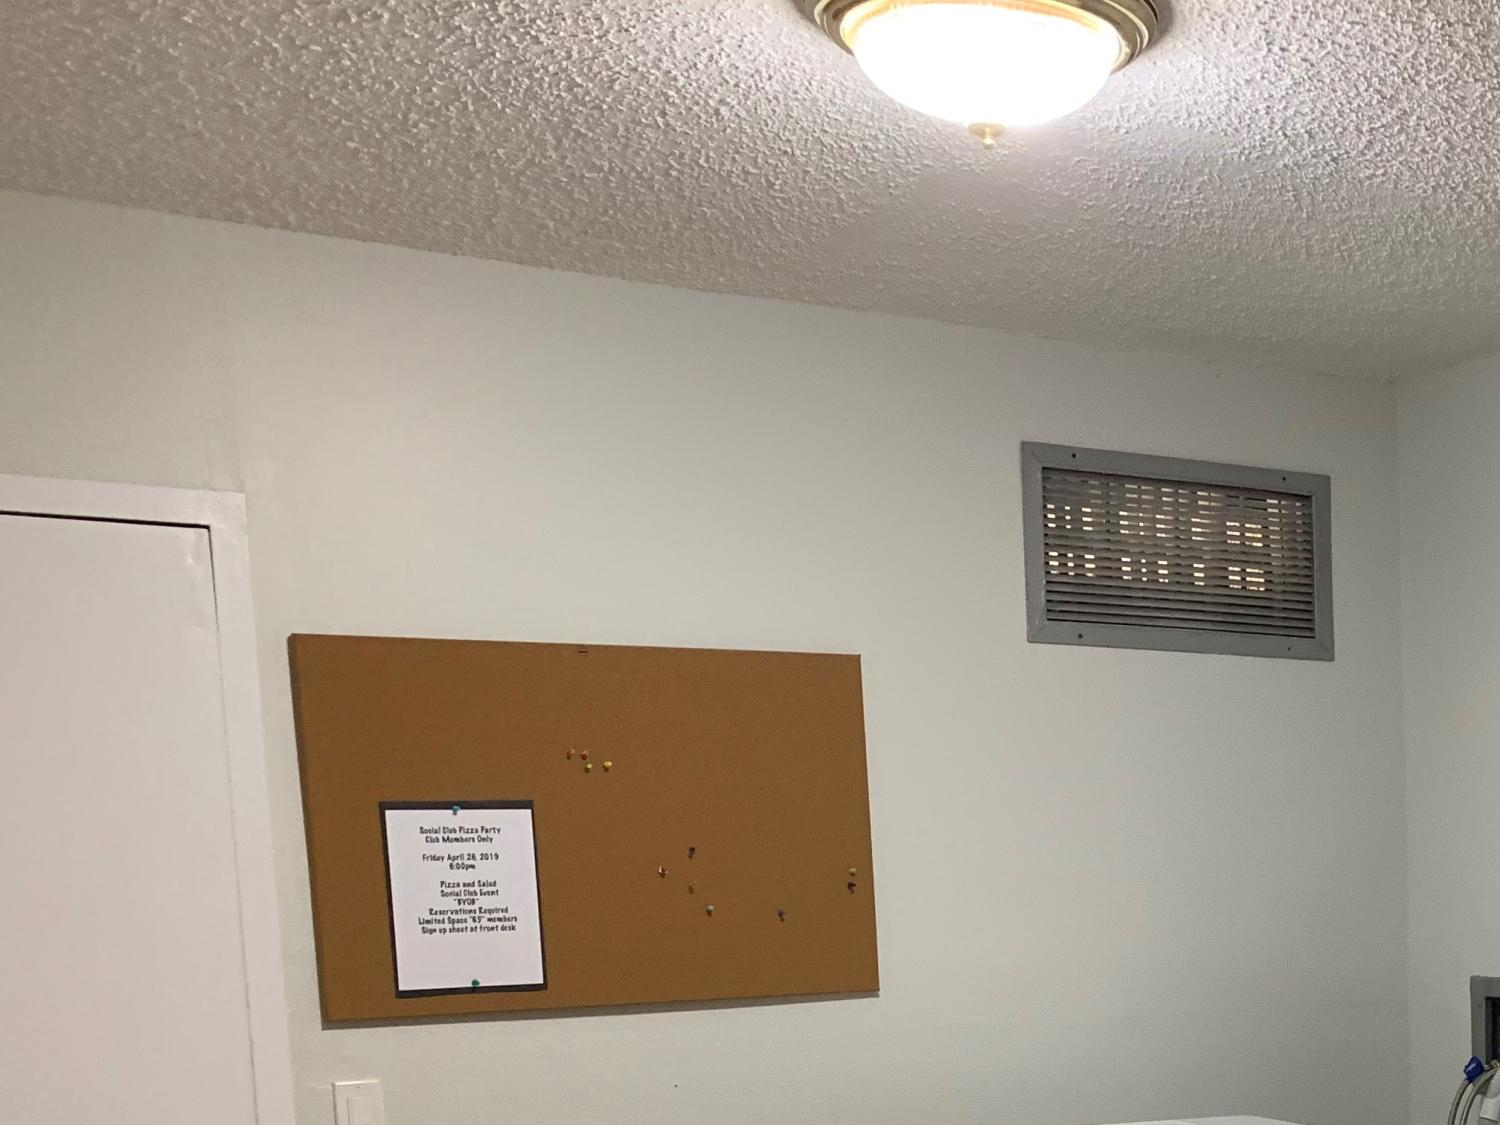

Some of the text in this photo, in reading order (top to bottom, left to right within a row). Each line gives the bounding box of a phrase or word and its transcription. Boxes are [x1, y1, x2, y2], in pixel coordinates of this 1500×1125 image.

[420, 826, 440, 834] Social
[481, 826, 501, 834] Party
[477, 835, 493, 843] Only
[423, 854, 444, 862] Friday
[479, 907, 508, 915] Required
[418, 917, 445, 925] Limited
[447, 916, 467, 925] Space
[422, 926, 436, 934] Sign
